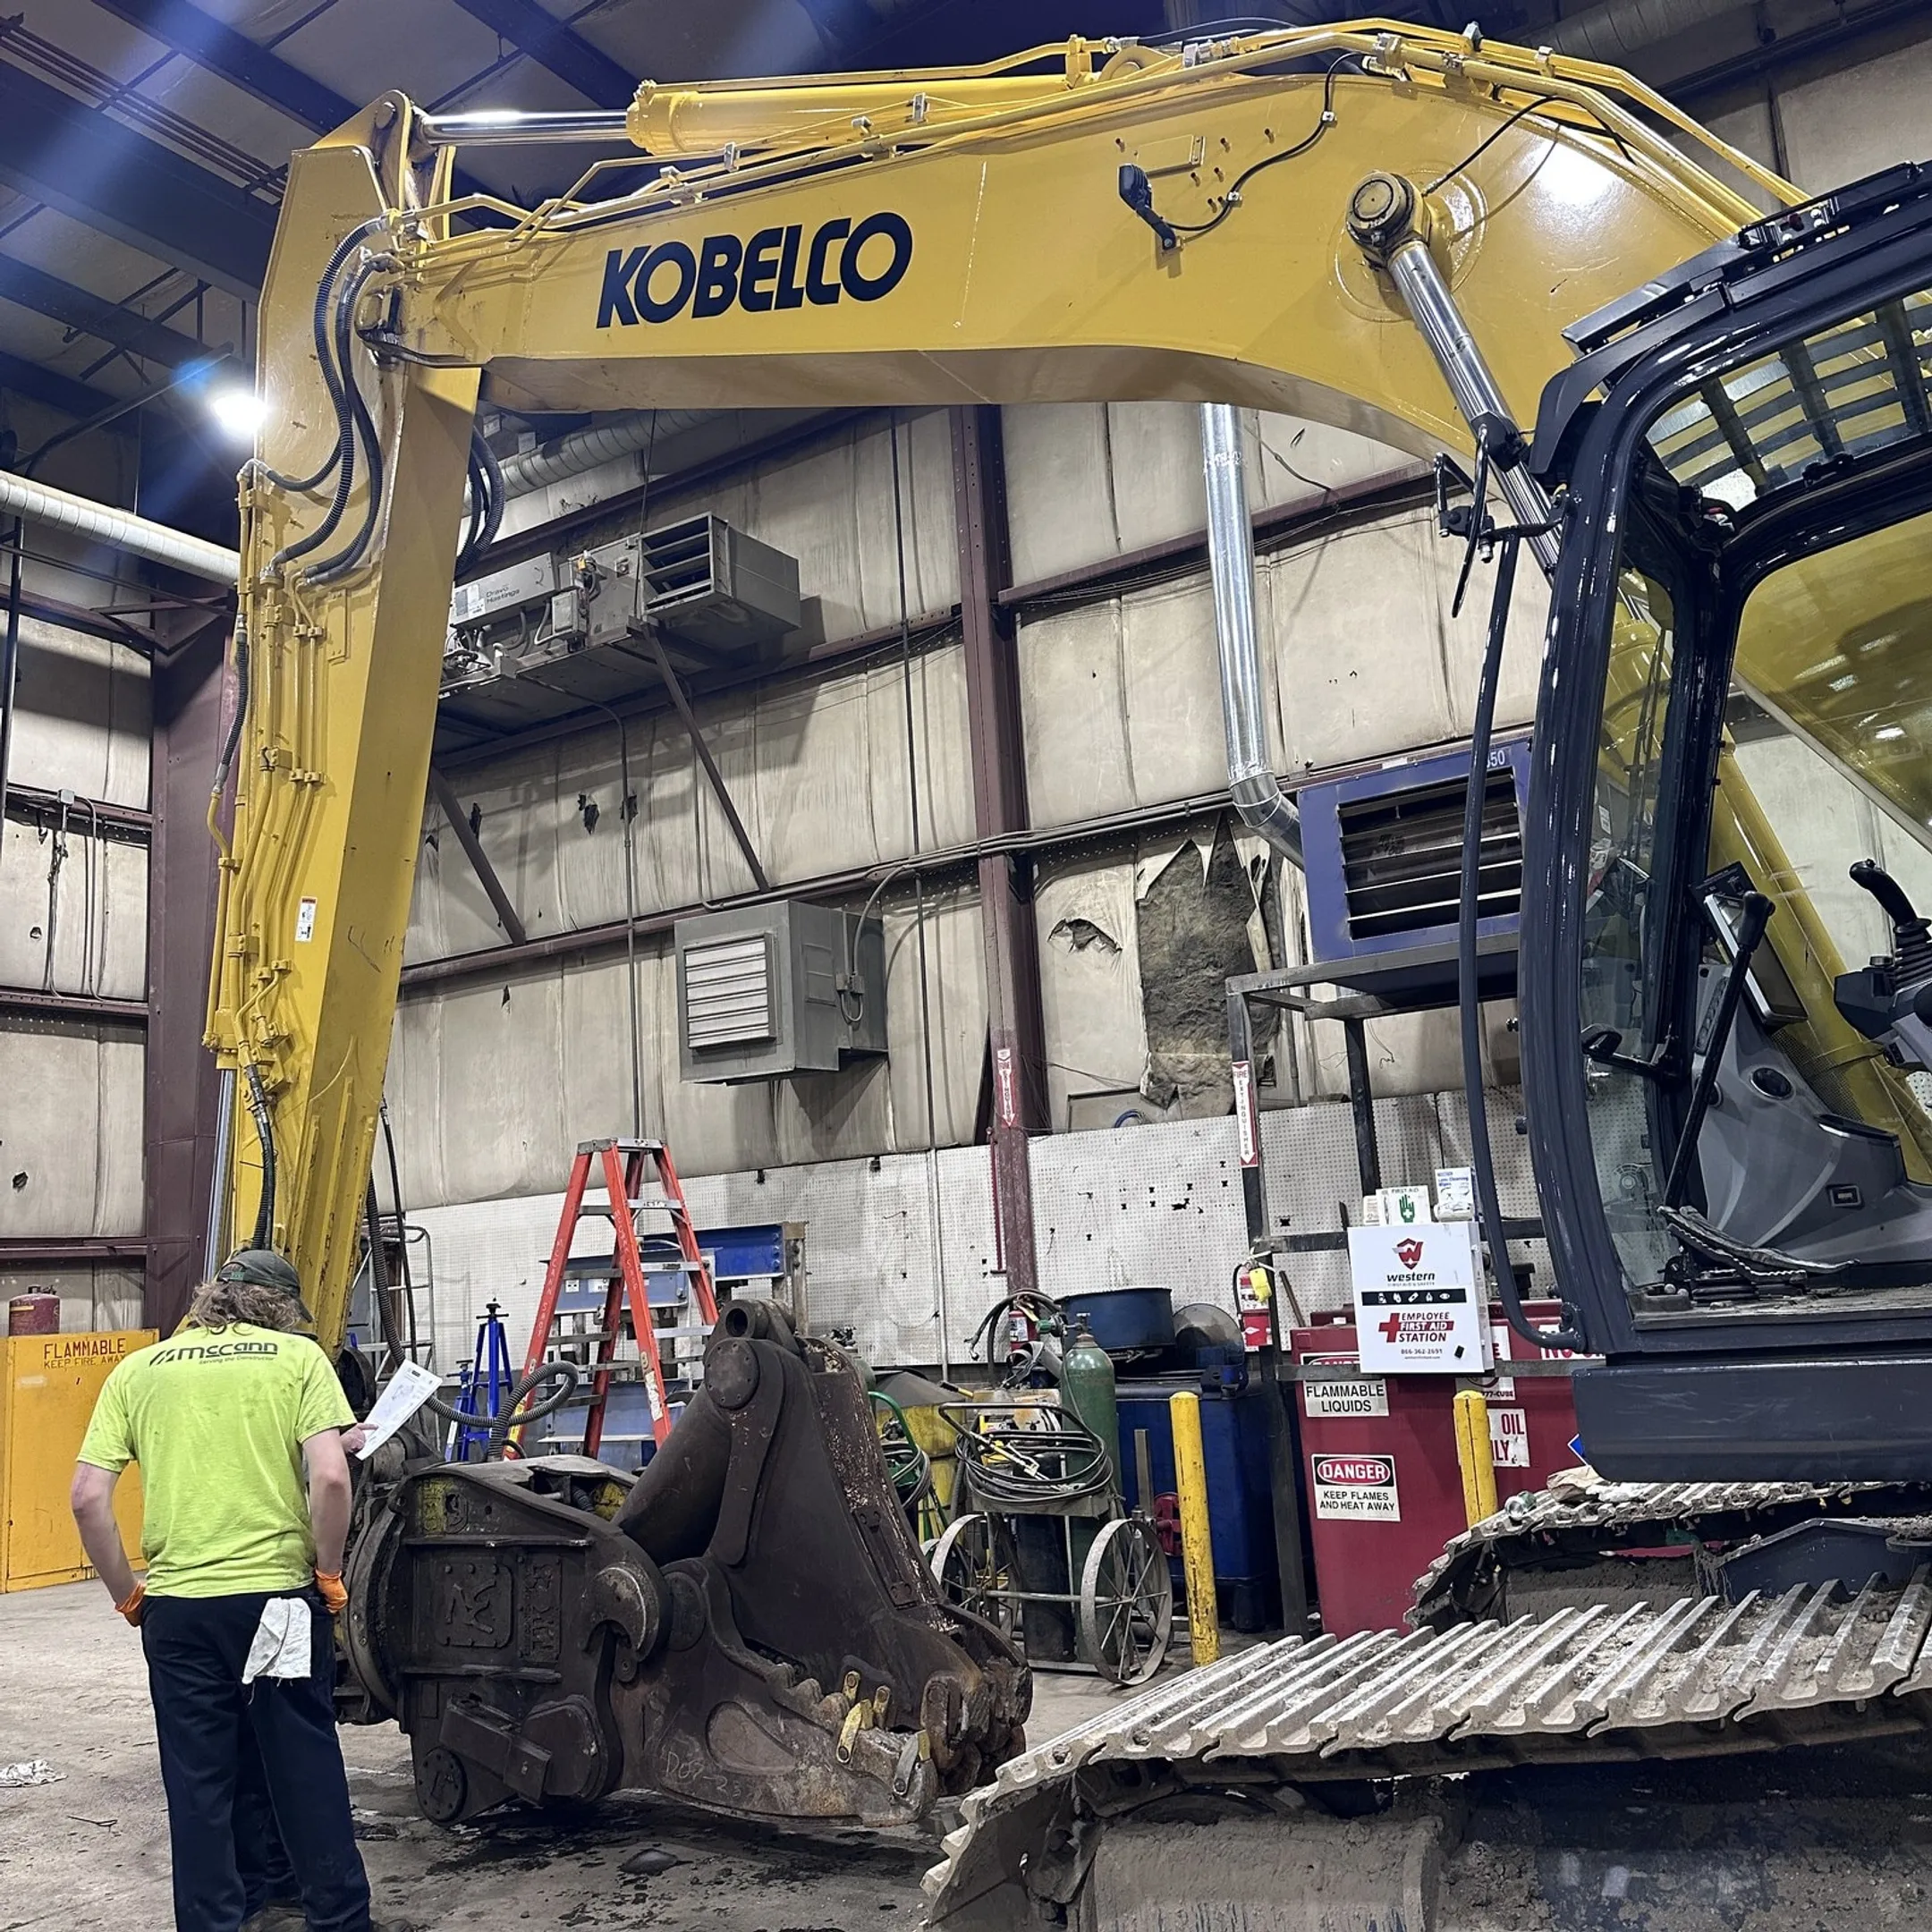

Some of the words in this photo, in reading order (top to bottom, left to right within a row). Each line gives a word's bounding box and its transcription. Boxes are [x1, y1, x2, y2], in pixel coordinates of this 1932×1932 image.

[596, 212, 912, 328] KOBELCO
[1386, 1271, 1436, 1282] western
[1402, 1311, 1450, 1320] EMPLOYEE
[1400, 1321, 1424, 1331] FIRST
[1428, 1321, 1448, 1331] AID
[1399, 1332, 1447, 1343] STATION
[44, 1338, 126, 1360] FLAMMABLE
[45, 1359, 72, 1369] KEEP
[74, 1357, 96, 1367] FIRE
[1306, 1385, 1385, 1397] FLAMMABLE
[1321, 1399, 1372, 1412] LIQUIDS
[1501, 1413, 1525, 1435] OIL
[1322, 1463, 1386, 1479] DANGER
[1323, 1490, 1348, 1499] KEEP
[1351, 1491, 1389, 1501] FLAMES
[1319, 1501, 1339, 1509] AND
[1340, 1501, 1365, 1510] HEAT
[1367, 1502, 1395, 1512] AWAY
